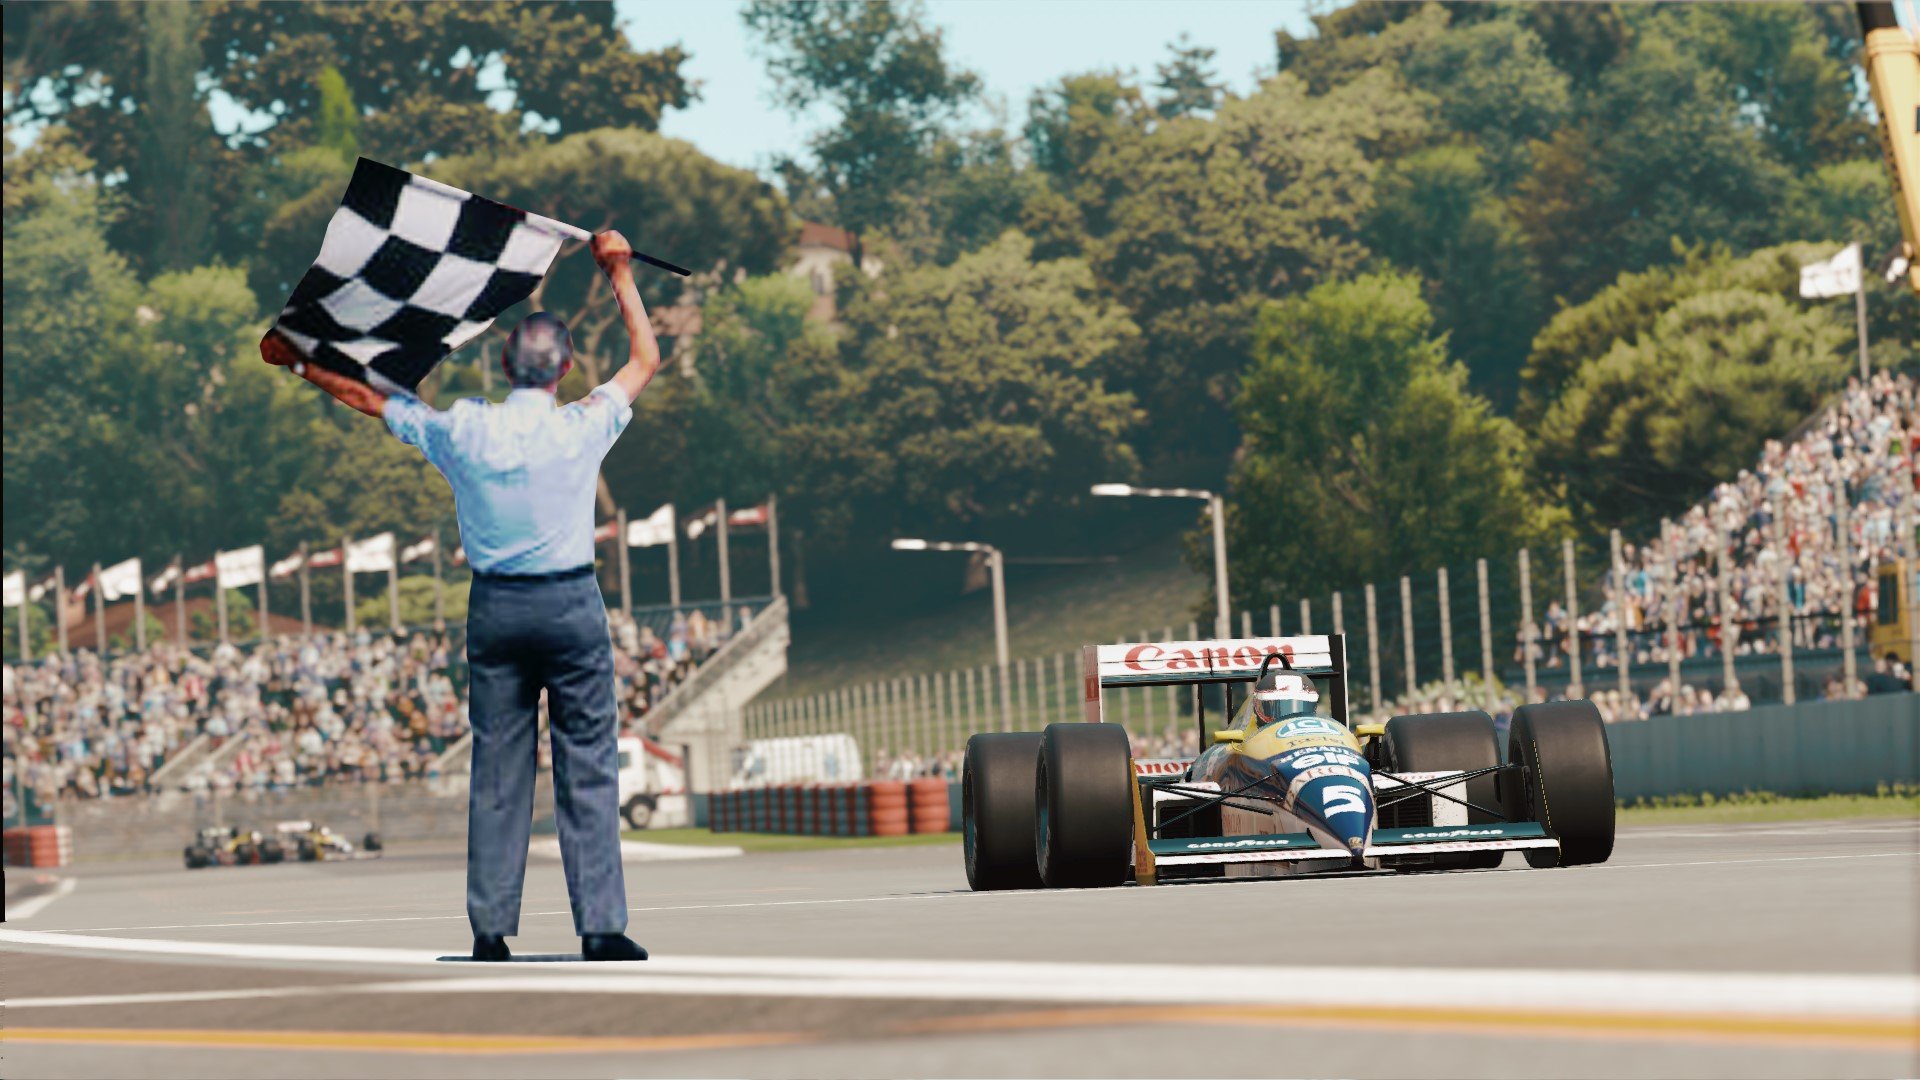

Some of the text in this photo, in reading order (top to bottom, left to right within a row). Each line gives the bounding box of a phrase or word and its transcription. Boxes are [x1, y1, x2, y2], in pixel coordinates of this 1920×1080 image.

[1125, 643, 1294, 671] Canon
[1292, 752, 1359, 769] elf
[1323, 785, 1366, 819] 5
[1187, 839, 1289, 848] GOODYEAR
